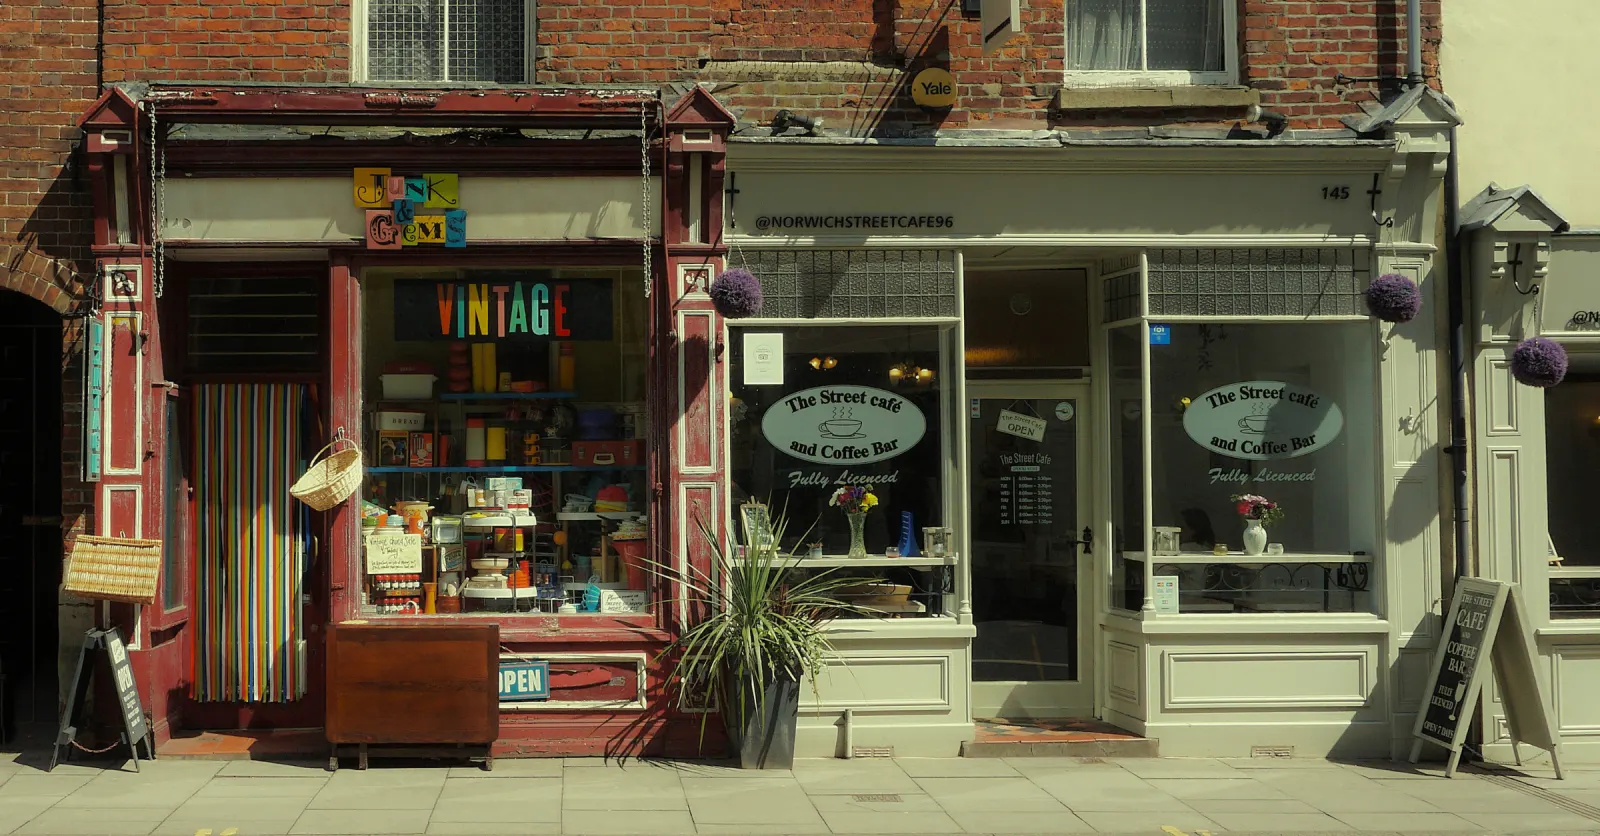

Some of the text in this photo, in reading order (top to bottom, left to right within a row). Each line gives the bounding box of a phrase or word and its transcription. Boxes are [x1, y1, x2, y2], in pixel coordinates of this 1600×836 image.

[921, 82, 952, 95] Yale
[1321, 186, 1350, 200] 145
[396, 199, 414, 223] &
[755, 215, 954, 230] @NORWICHSTREETCAFE96
[437, 281, 571, 338] VINTAGE
[785, 389, 903, 414] The Street café
[1205, 385, 1320, 409] The Street café
[392, 417, 421, 425] BREAD
[1008, 423, 1035, 436] OPEN
[789, 438, 899, 460] and Coffee Bar
[1210, 434, 1316, 455] and Coffee Bar
[1000, 452, 1051, 465] The Street Cafe
[787, 469, 899, 488] Fully Licenced
[1208, 467, 1316, 485] Fully Licenced
[1461, 594, 1493, 608] THE STREET
[1457, 609, 1487, 631] CAFÉ
[1448, 641, 1478, 660] COFFEE
[1448, 657, 1466, 674] BAR
[1439, 684, 1454, 697] FULLY
[1431, 695, 1454, 710] LICENCED
[1424, 720, 1438, 733] OPEN
[1441, 726, 1455, 739] DAYS
